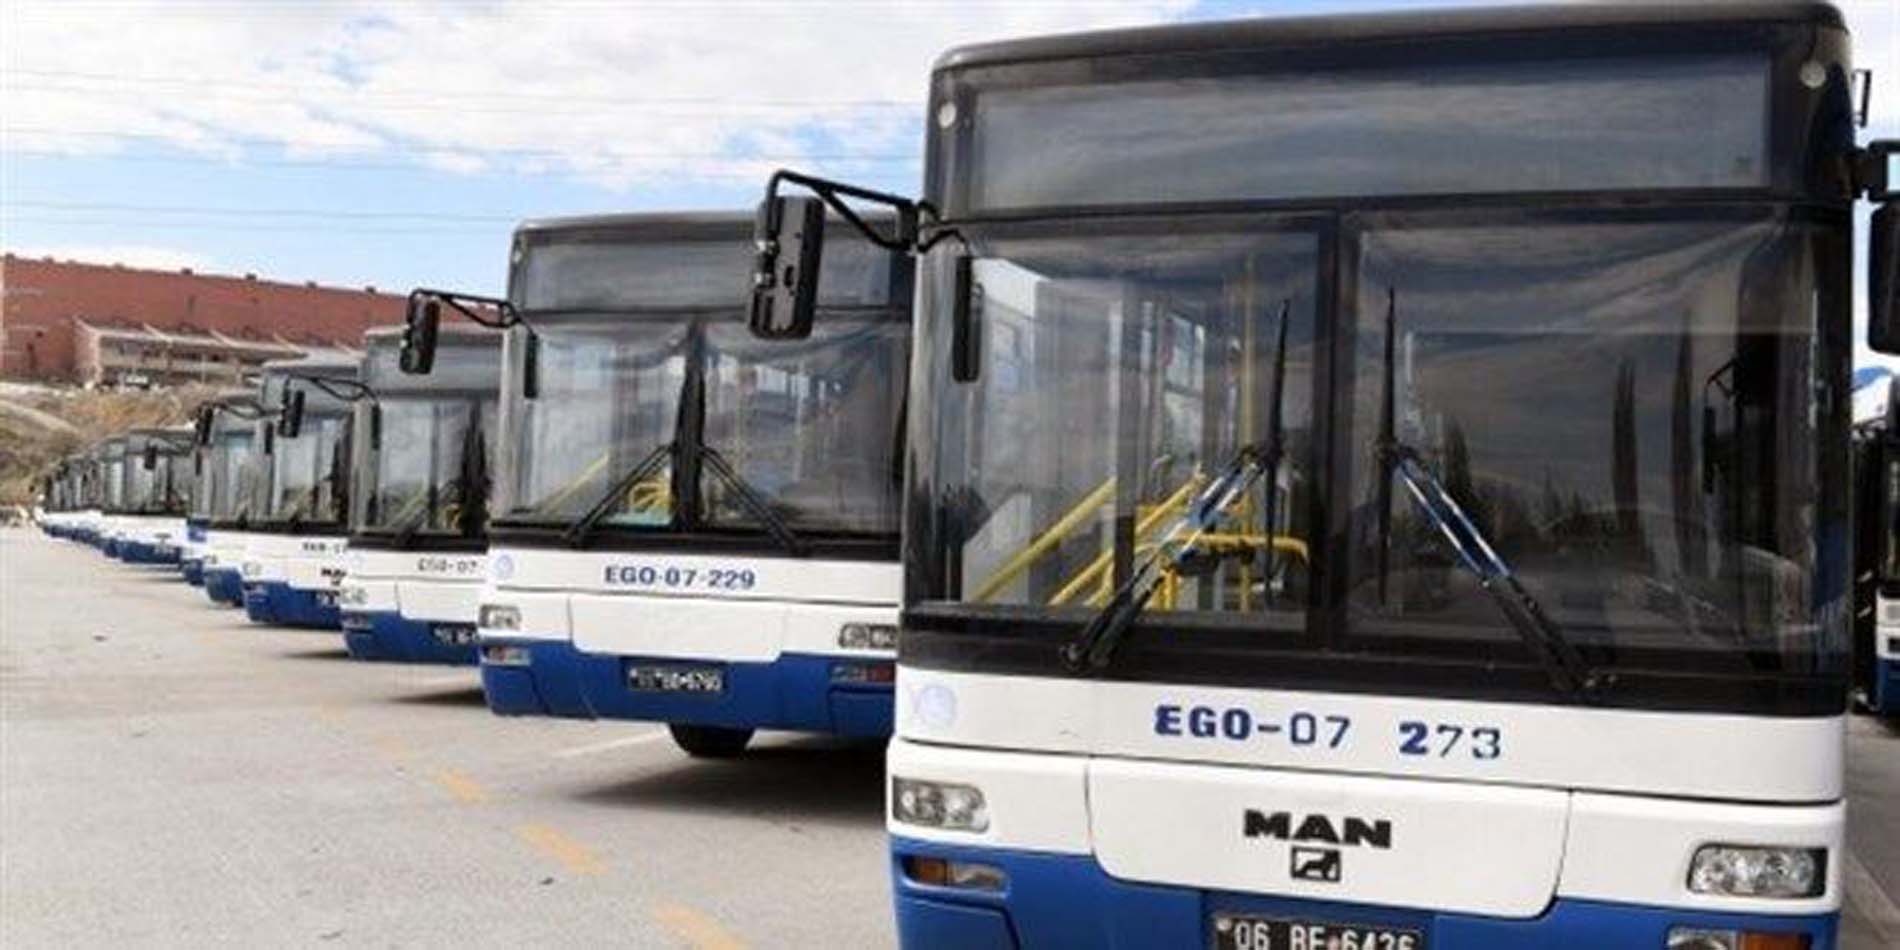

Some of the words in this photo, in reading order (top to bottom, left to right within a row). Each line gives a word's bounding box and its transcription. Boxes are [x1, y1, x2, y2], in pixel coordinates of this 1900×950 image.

[1154, 704, 1352, 748] EGO-07
[1399, 720, 1502, 760] 273
[1243, 808, 1392, 849] MAN
[1233, 921, 1270, 950] 06
